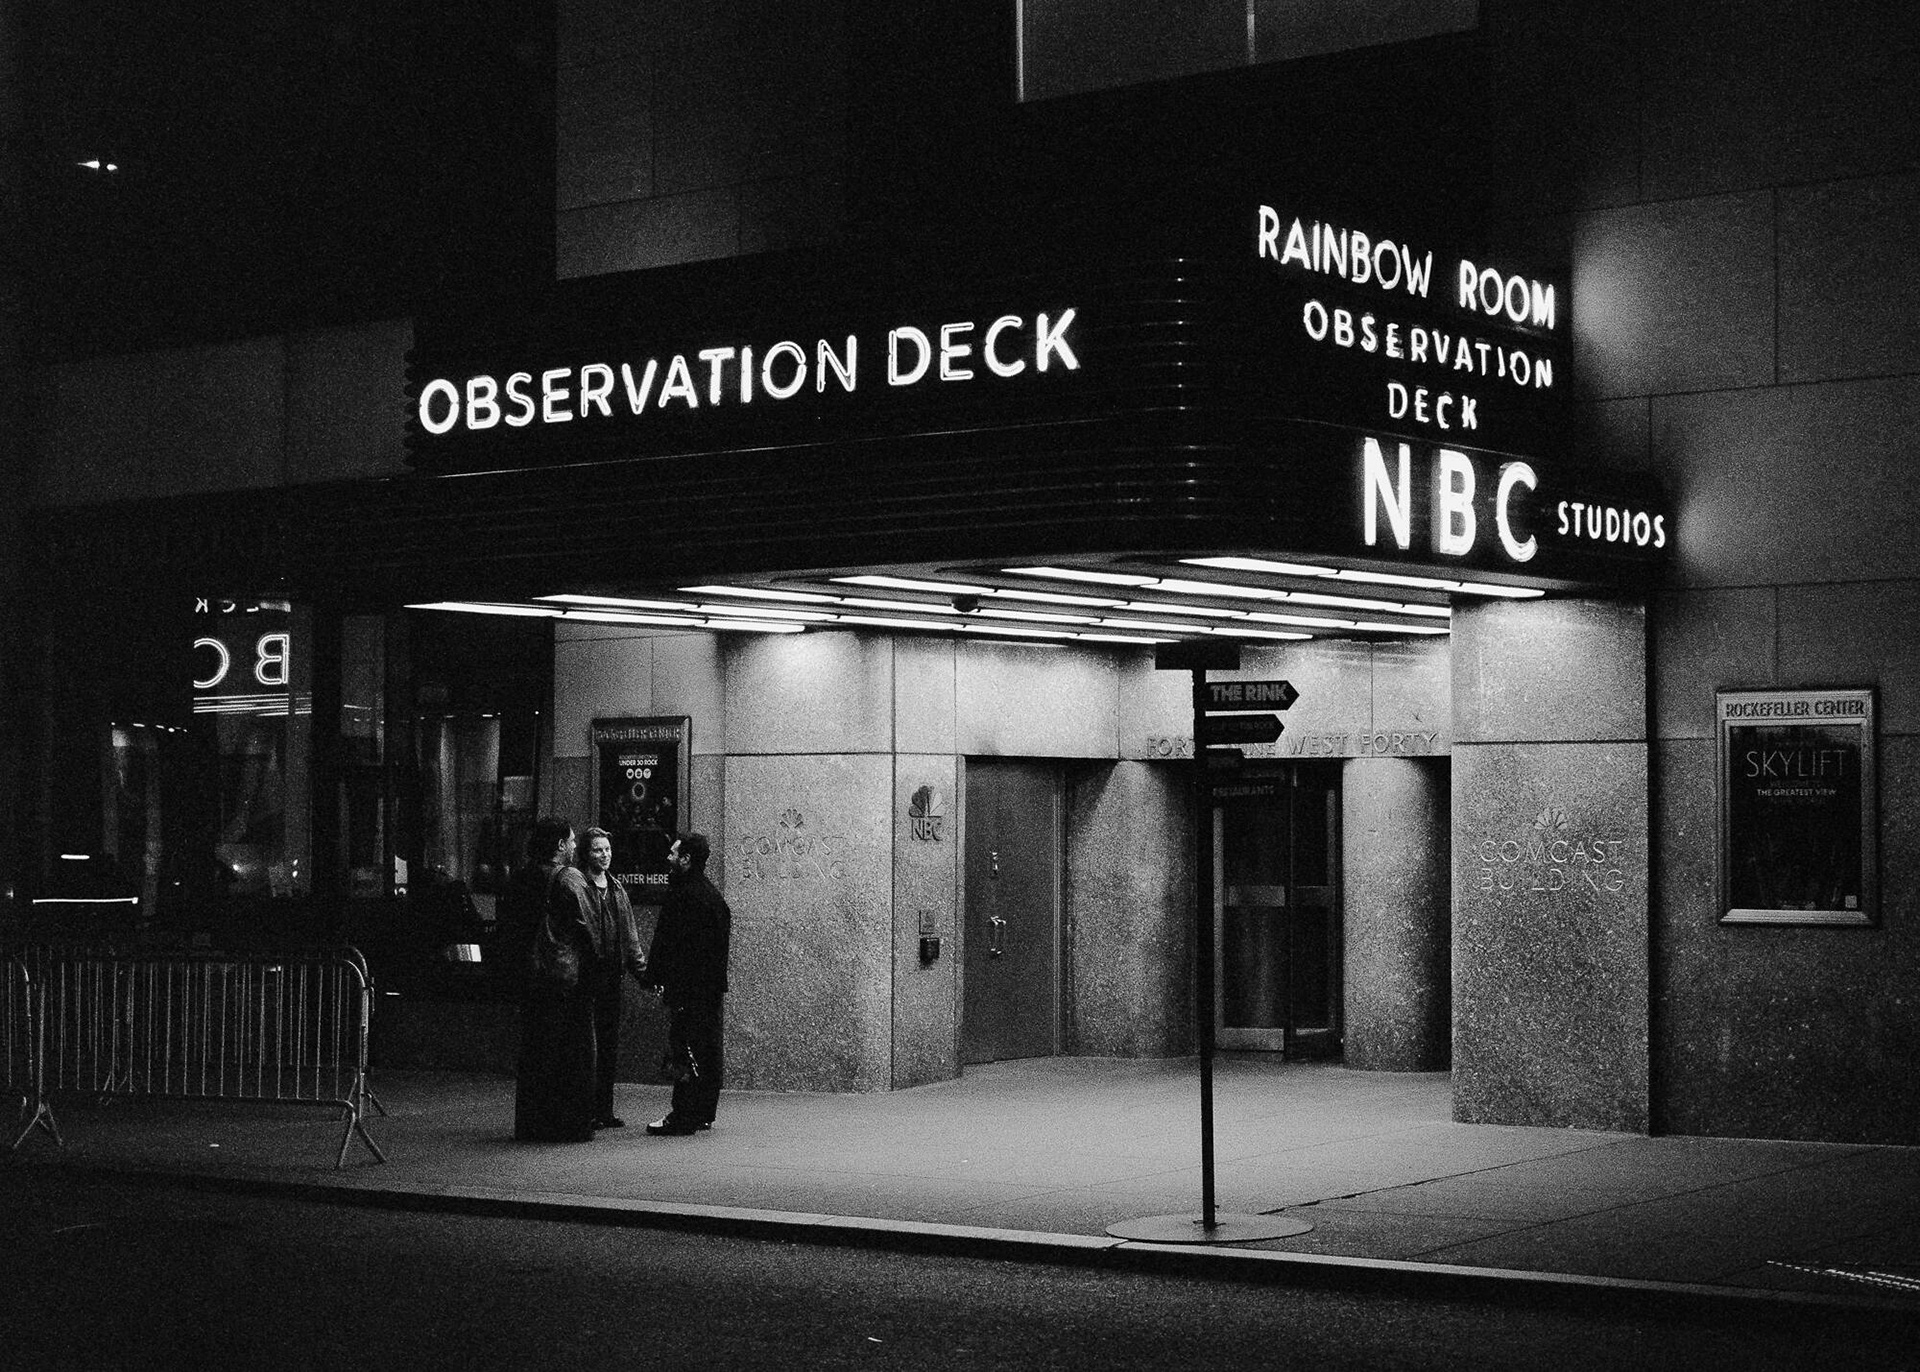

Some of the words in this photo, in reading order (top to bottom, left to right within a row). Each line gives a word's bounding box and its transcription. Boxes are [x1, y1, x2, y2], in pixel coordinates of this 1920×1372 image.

[1258, 204, 1434, 298] RAINBOW
[1458, 258, 1556, 330] ROOM
[1303, 299, 1553, 389] OBSERVATION
[418, 334, 858, 435] OBSERVATION
[887, 307, 1081, 386] DECK
[1387, 381, 1478, 430] DECK
[1362, 436, 1539, 563] NBC
[1557, 500, 1667, 549] STUDIOS
[1210, 684, 1242, 702] THE
[1245, 683, 1287, 702] RINK
[1725, 700, 1810, 718] ROCKEFELLER
[1814, 699, 1865, 716] CENTER
[1287, 734, 1349, 756] WEST
[1359, 732, 1438, 754] FORTY
[644, 758, 659, 766] ROCK
[1745, 749, 1847, 777] SKYLIFT
[1756, 788, 1771, 797] THE
[1773, 788, 1813, 797] GREATEST
[1815, 788, 1837, 796] VIEW
[911, 822, 943, 842] NBC
[1479, 839, 1623, 864] COMCAST
[617, 873, 645, 885] ENTER
[647, 873, 670, 885] HERE
